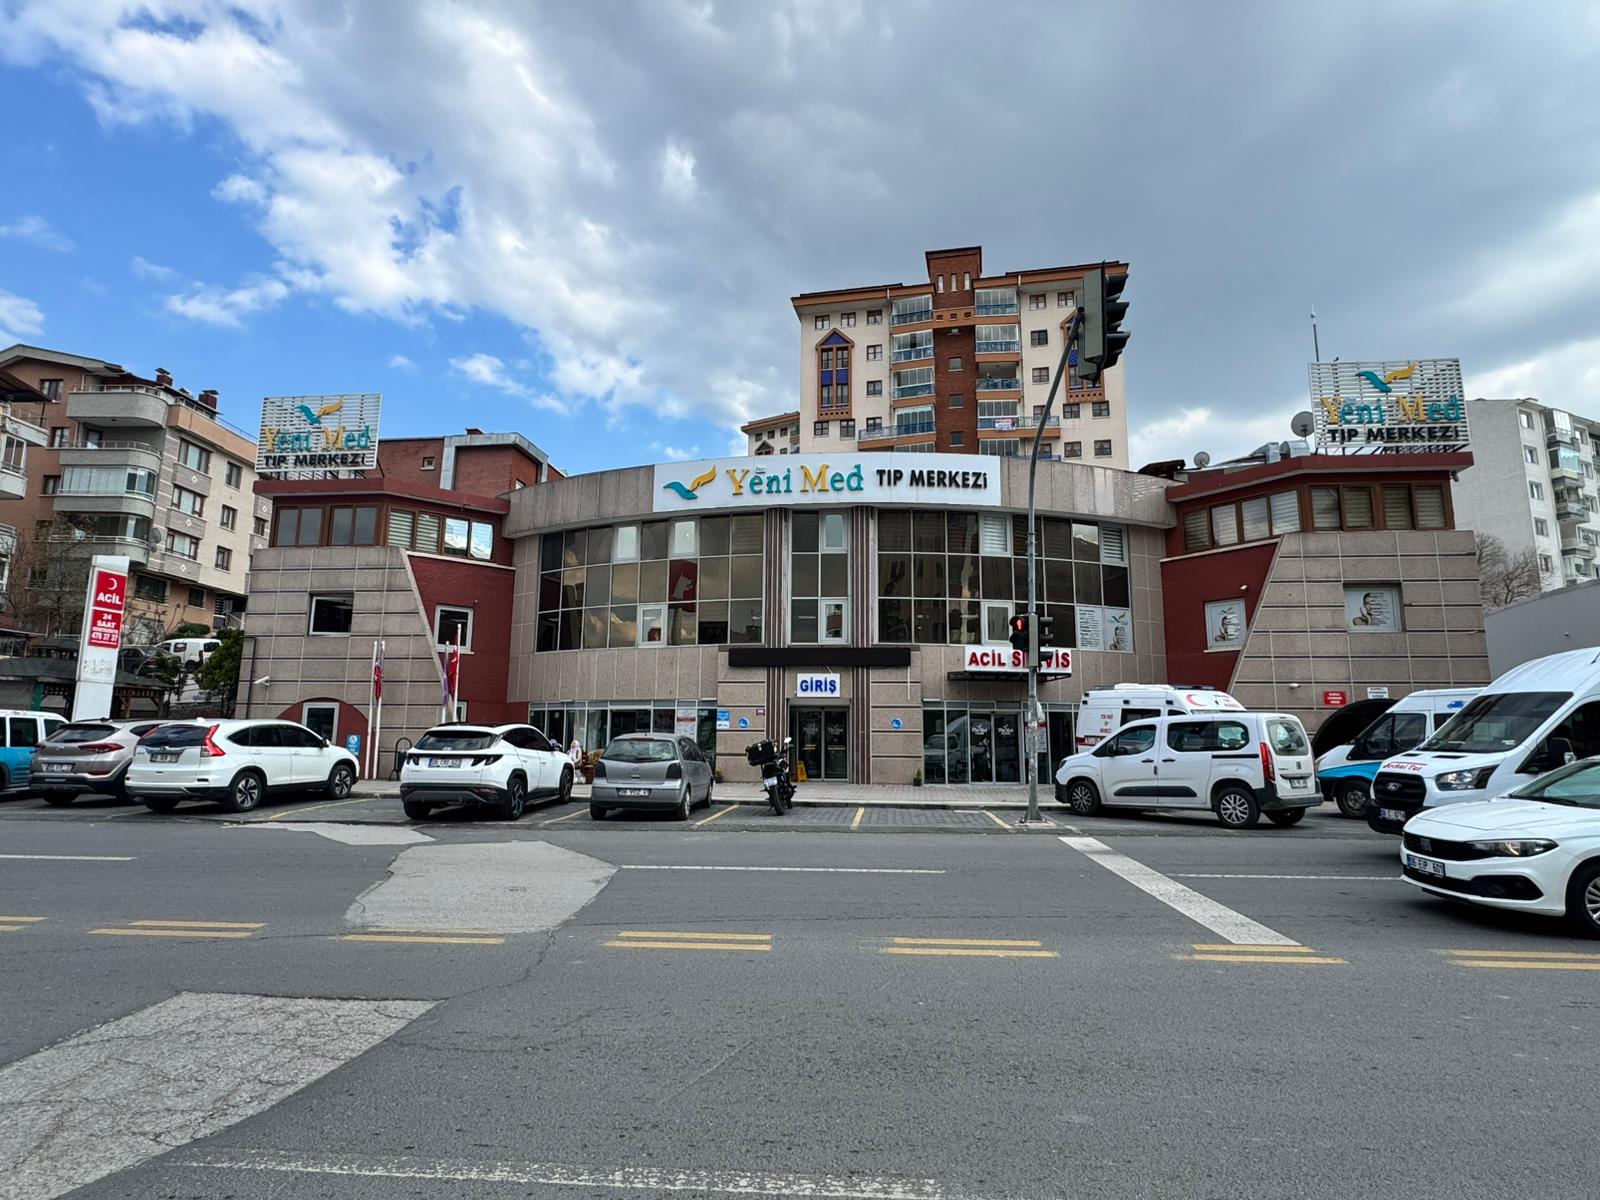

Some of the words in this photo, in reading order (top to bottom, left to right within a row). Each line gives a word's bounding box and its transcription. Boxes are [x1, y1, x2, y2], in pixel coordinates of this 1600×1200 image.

[1320, 396, 1386, 425] Yeni
[1396, 394, 1464, 423] Med
[321, 424, 372, 450] Med
[1327, 428, 1359, 443] TIP
[263, 455, 287, 467] TIP
[726, 467, 792, 496] Yeni
[800, 463, 864, 492] Med
[876, 469, 904, 487] TIP
[97, 592, 122, 605] ACİL
[97, 620, 117, 629] SAAT
[103, 613, 113, 621] 24
[968, 650, 1006, 667] ACİL
[800, 676, 837, 694] GİRİŞ
